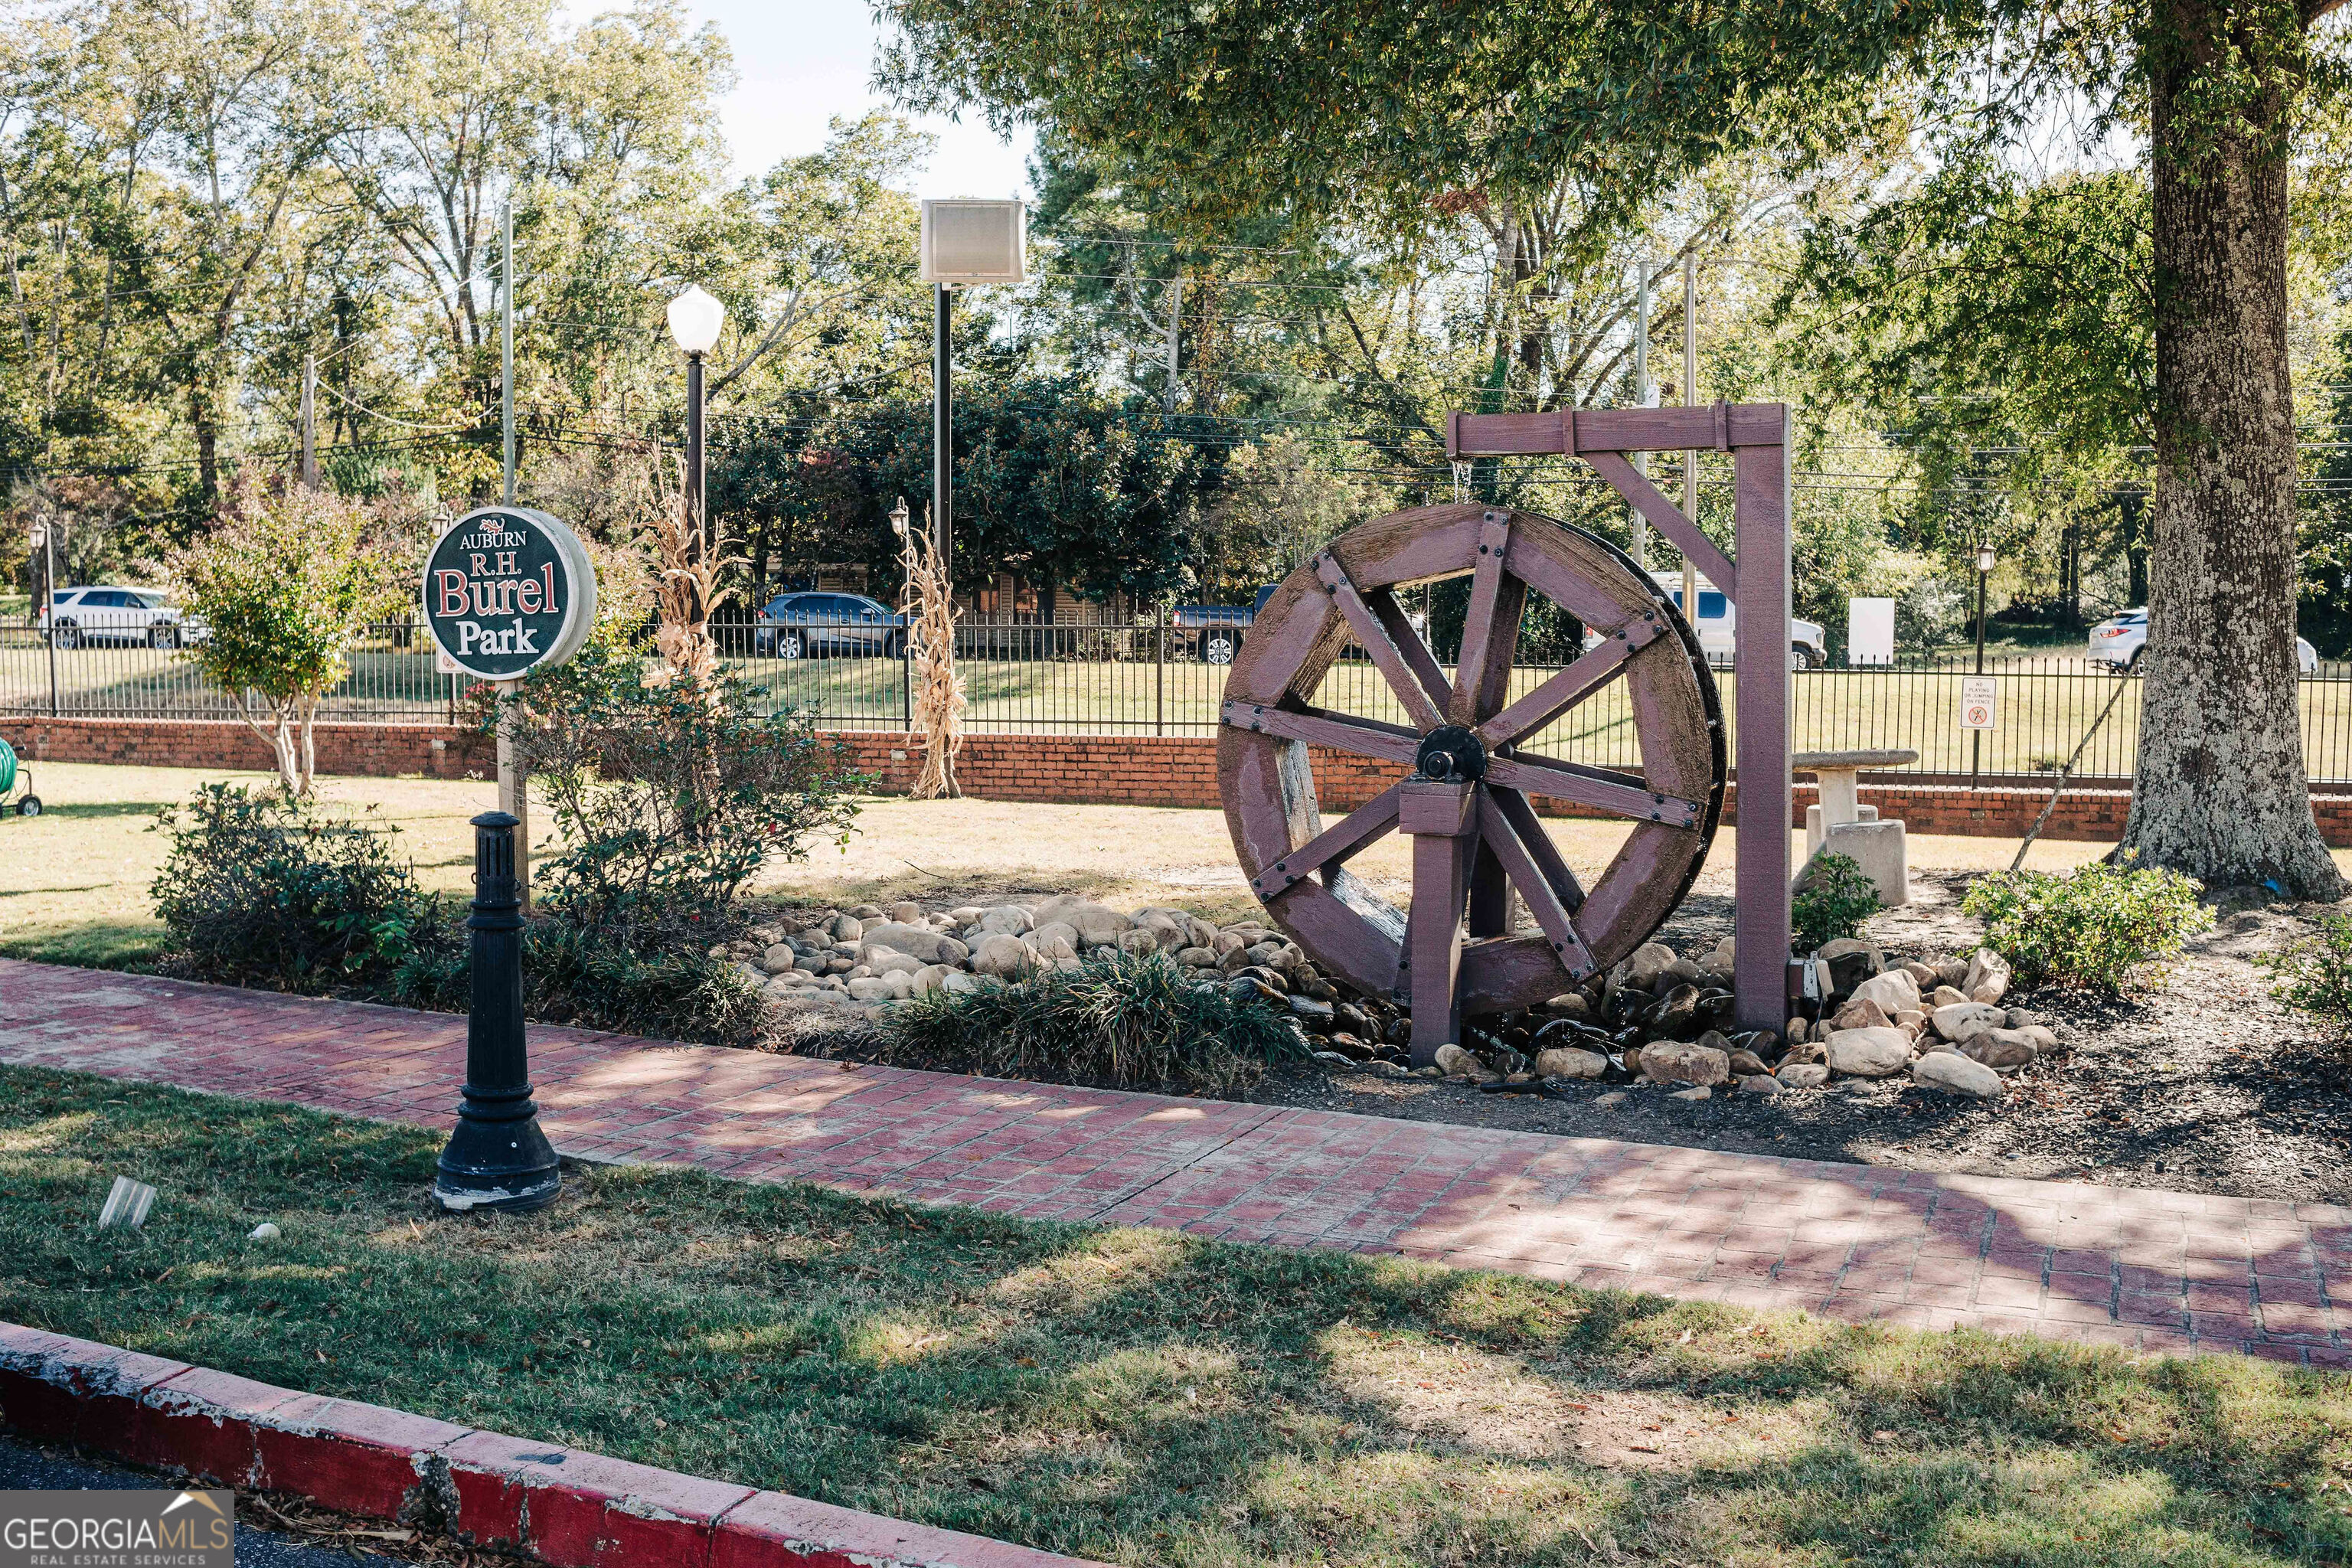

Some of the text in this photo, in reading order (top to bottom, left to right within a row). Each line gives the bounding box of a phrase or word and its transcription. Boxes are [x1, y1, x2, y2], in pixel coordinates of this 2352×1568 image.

[459, 531, 527, 550] AUBURN
[469, 551, 522, 577] R.H.
[433, 562, 559, 617] Burel
[456, 618, 539, 655] Park
